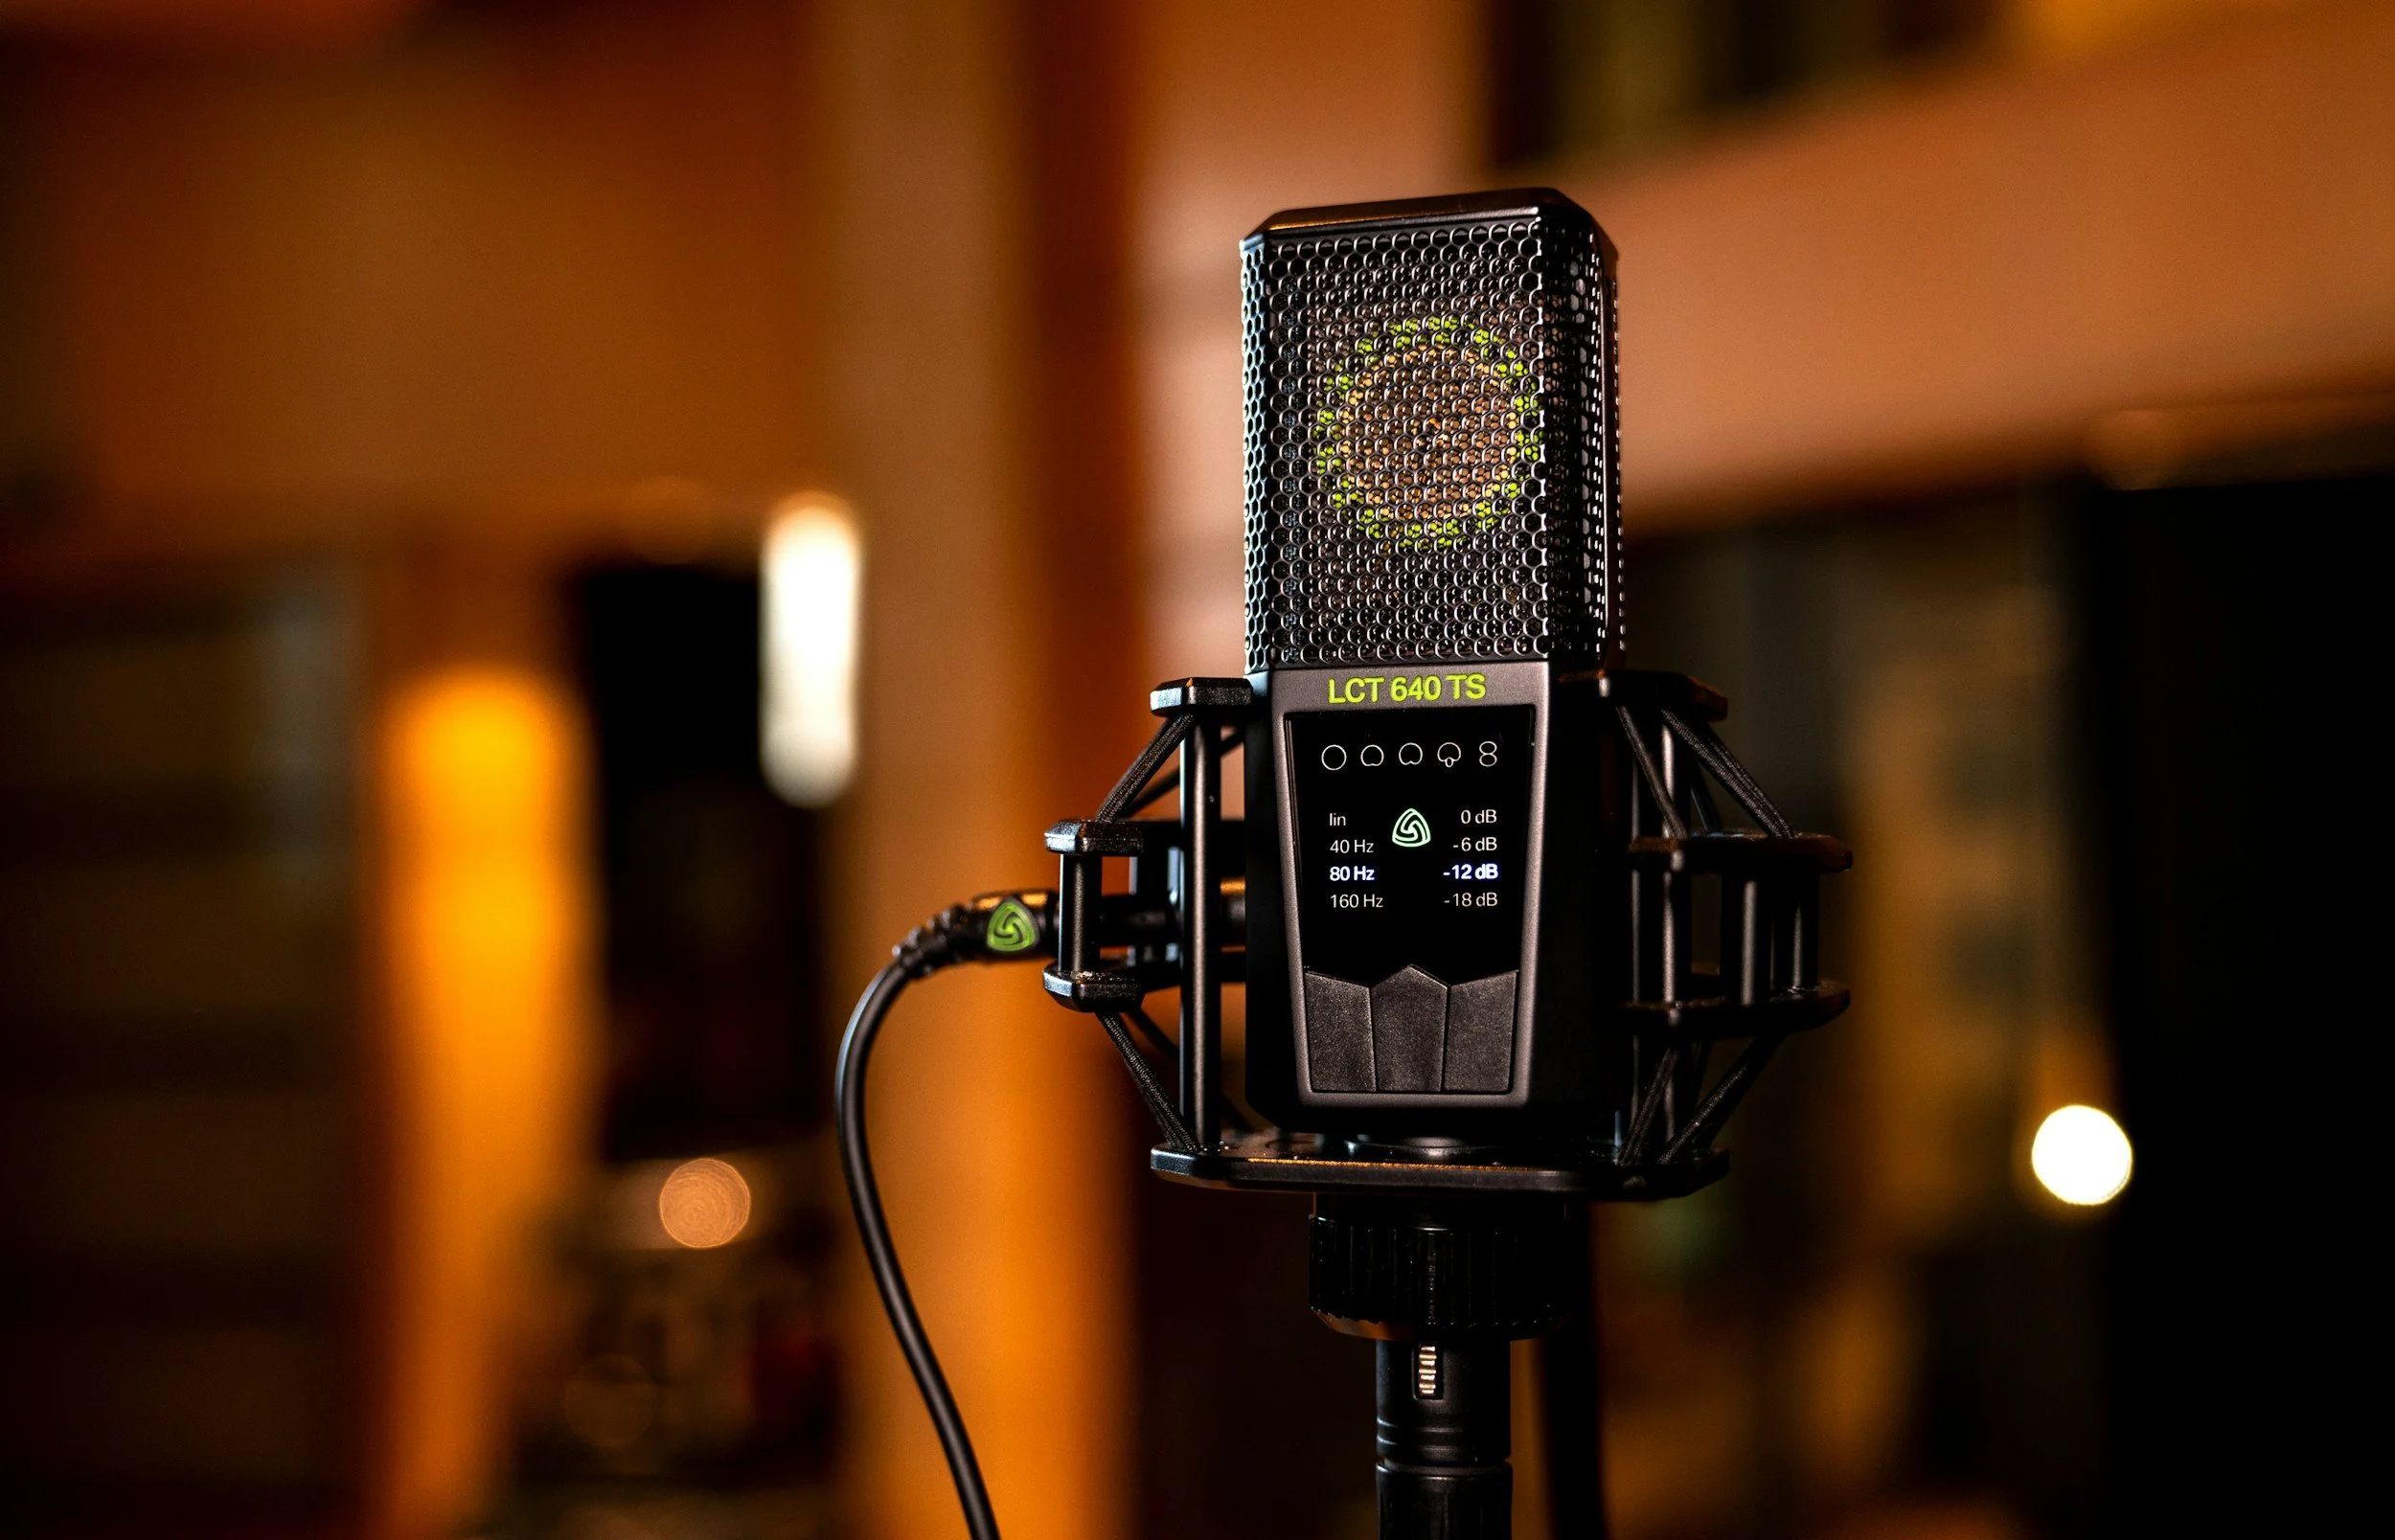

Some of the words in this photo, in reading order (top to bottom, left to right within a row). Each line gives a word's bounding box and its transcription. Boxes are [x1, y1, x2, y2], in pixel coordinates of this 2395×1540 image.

[1328, 676, 1385, 704] LCT
[1389, 674, 1442, 702] 640
[1446, 672, 1487, 700] TS
[1330, 813, 1346, 826] lin
[1461, 810, 1471, 824] 0
[1475, 809, 1496, 824] dB
[1330, 840, 1350, 853] 40
[1355, 839, 1374, 852] Hz
[1475, 837, 1497, 851] dB
[1330, 866, 1350, 881] 80
[1354, 866, 1375, 880] Hz
[1474, 863, 1498, 879] dB
[1331, 895, 1358, 908] 160
[1364, 894, 1383, 907] Hz
[1476, 893, 1497, 907] dB
